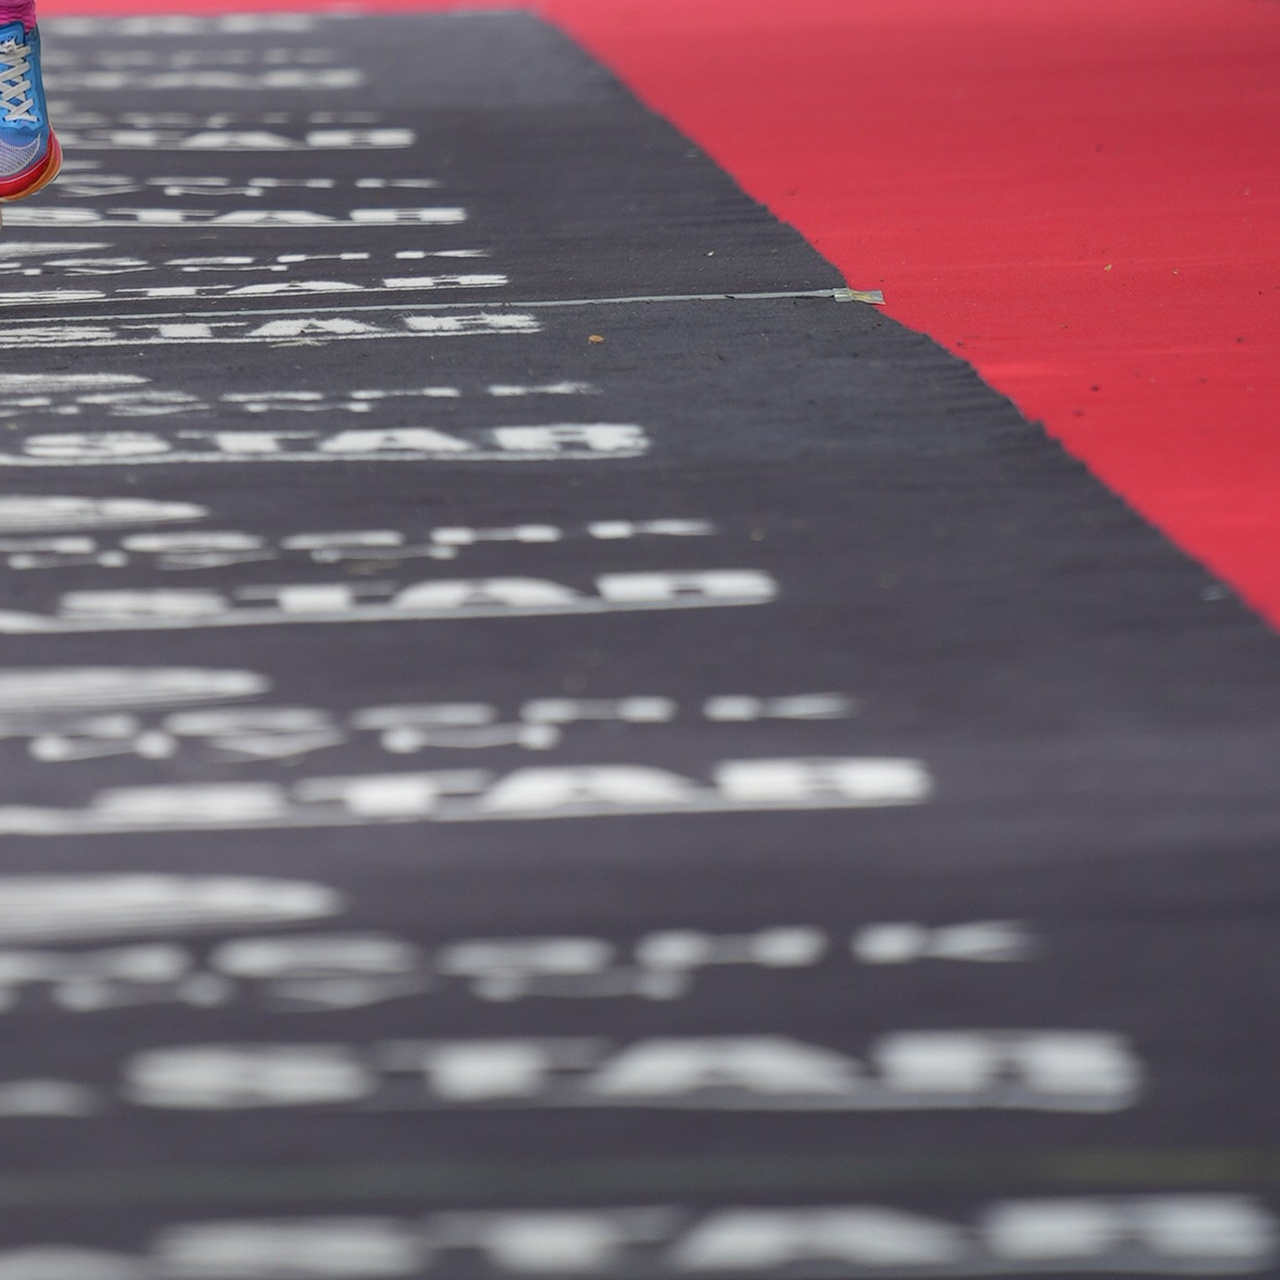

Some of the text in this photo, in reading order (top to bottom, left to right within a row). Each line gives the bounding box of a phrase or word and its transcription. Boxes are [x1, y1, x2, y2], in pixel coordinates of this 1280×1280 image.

[0, 207, 466, 223] STAR
[24, 423, 648, 458] STAR
[58, 568, 776, 621] STAR
[90, 755, 928, 822] STAR
